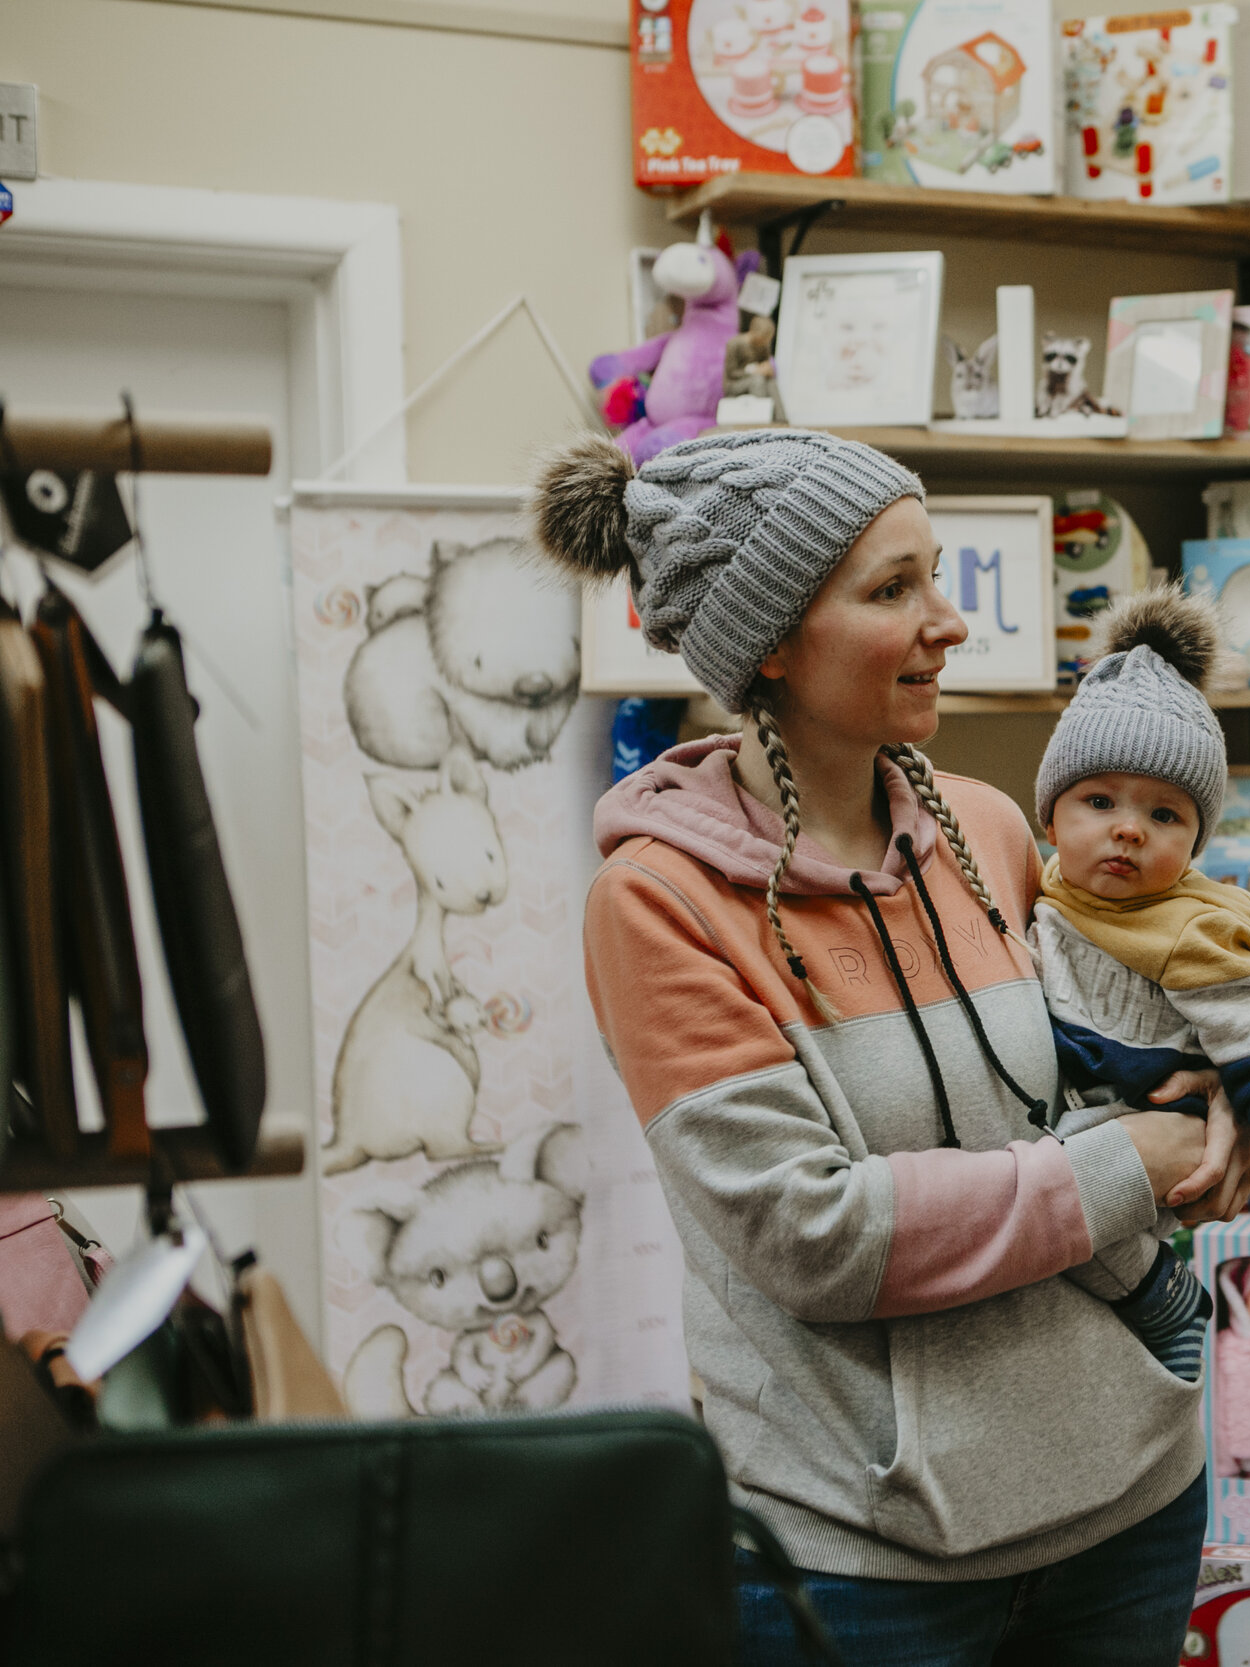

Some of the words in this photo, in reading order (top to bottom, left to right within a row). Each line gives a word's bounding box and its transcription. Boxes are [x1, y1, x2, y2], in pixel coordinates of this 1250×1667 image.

[647, 157, 680, 173] Pink
[683, 156, 707, 172] Tea
[709, 156, 740, 172] Tray
[1198, 1563, 1243, 1587] dex
